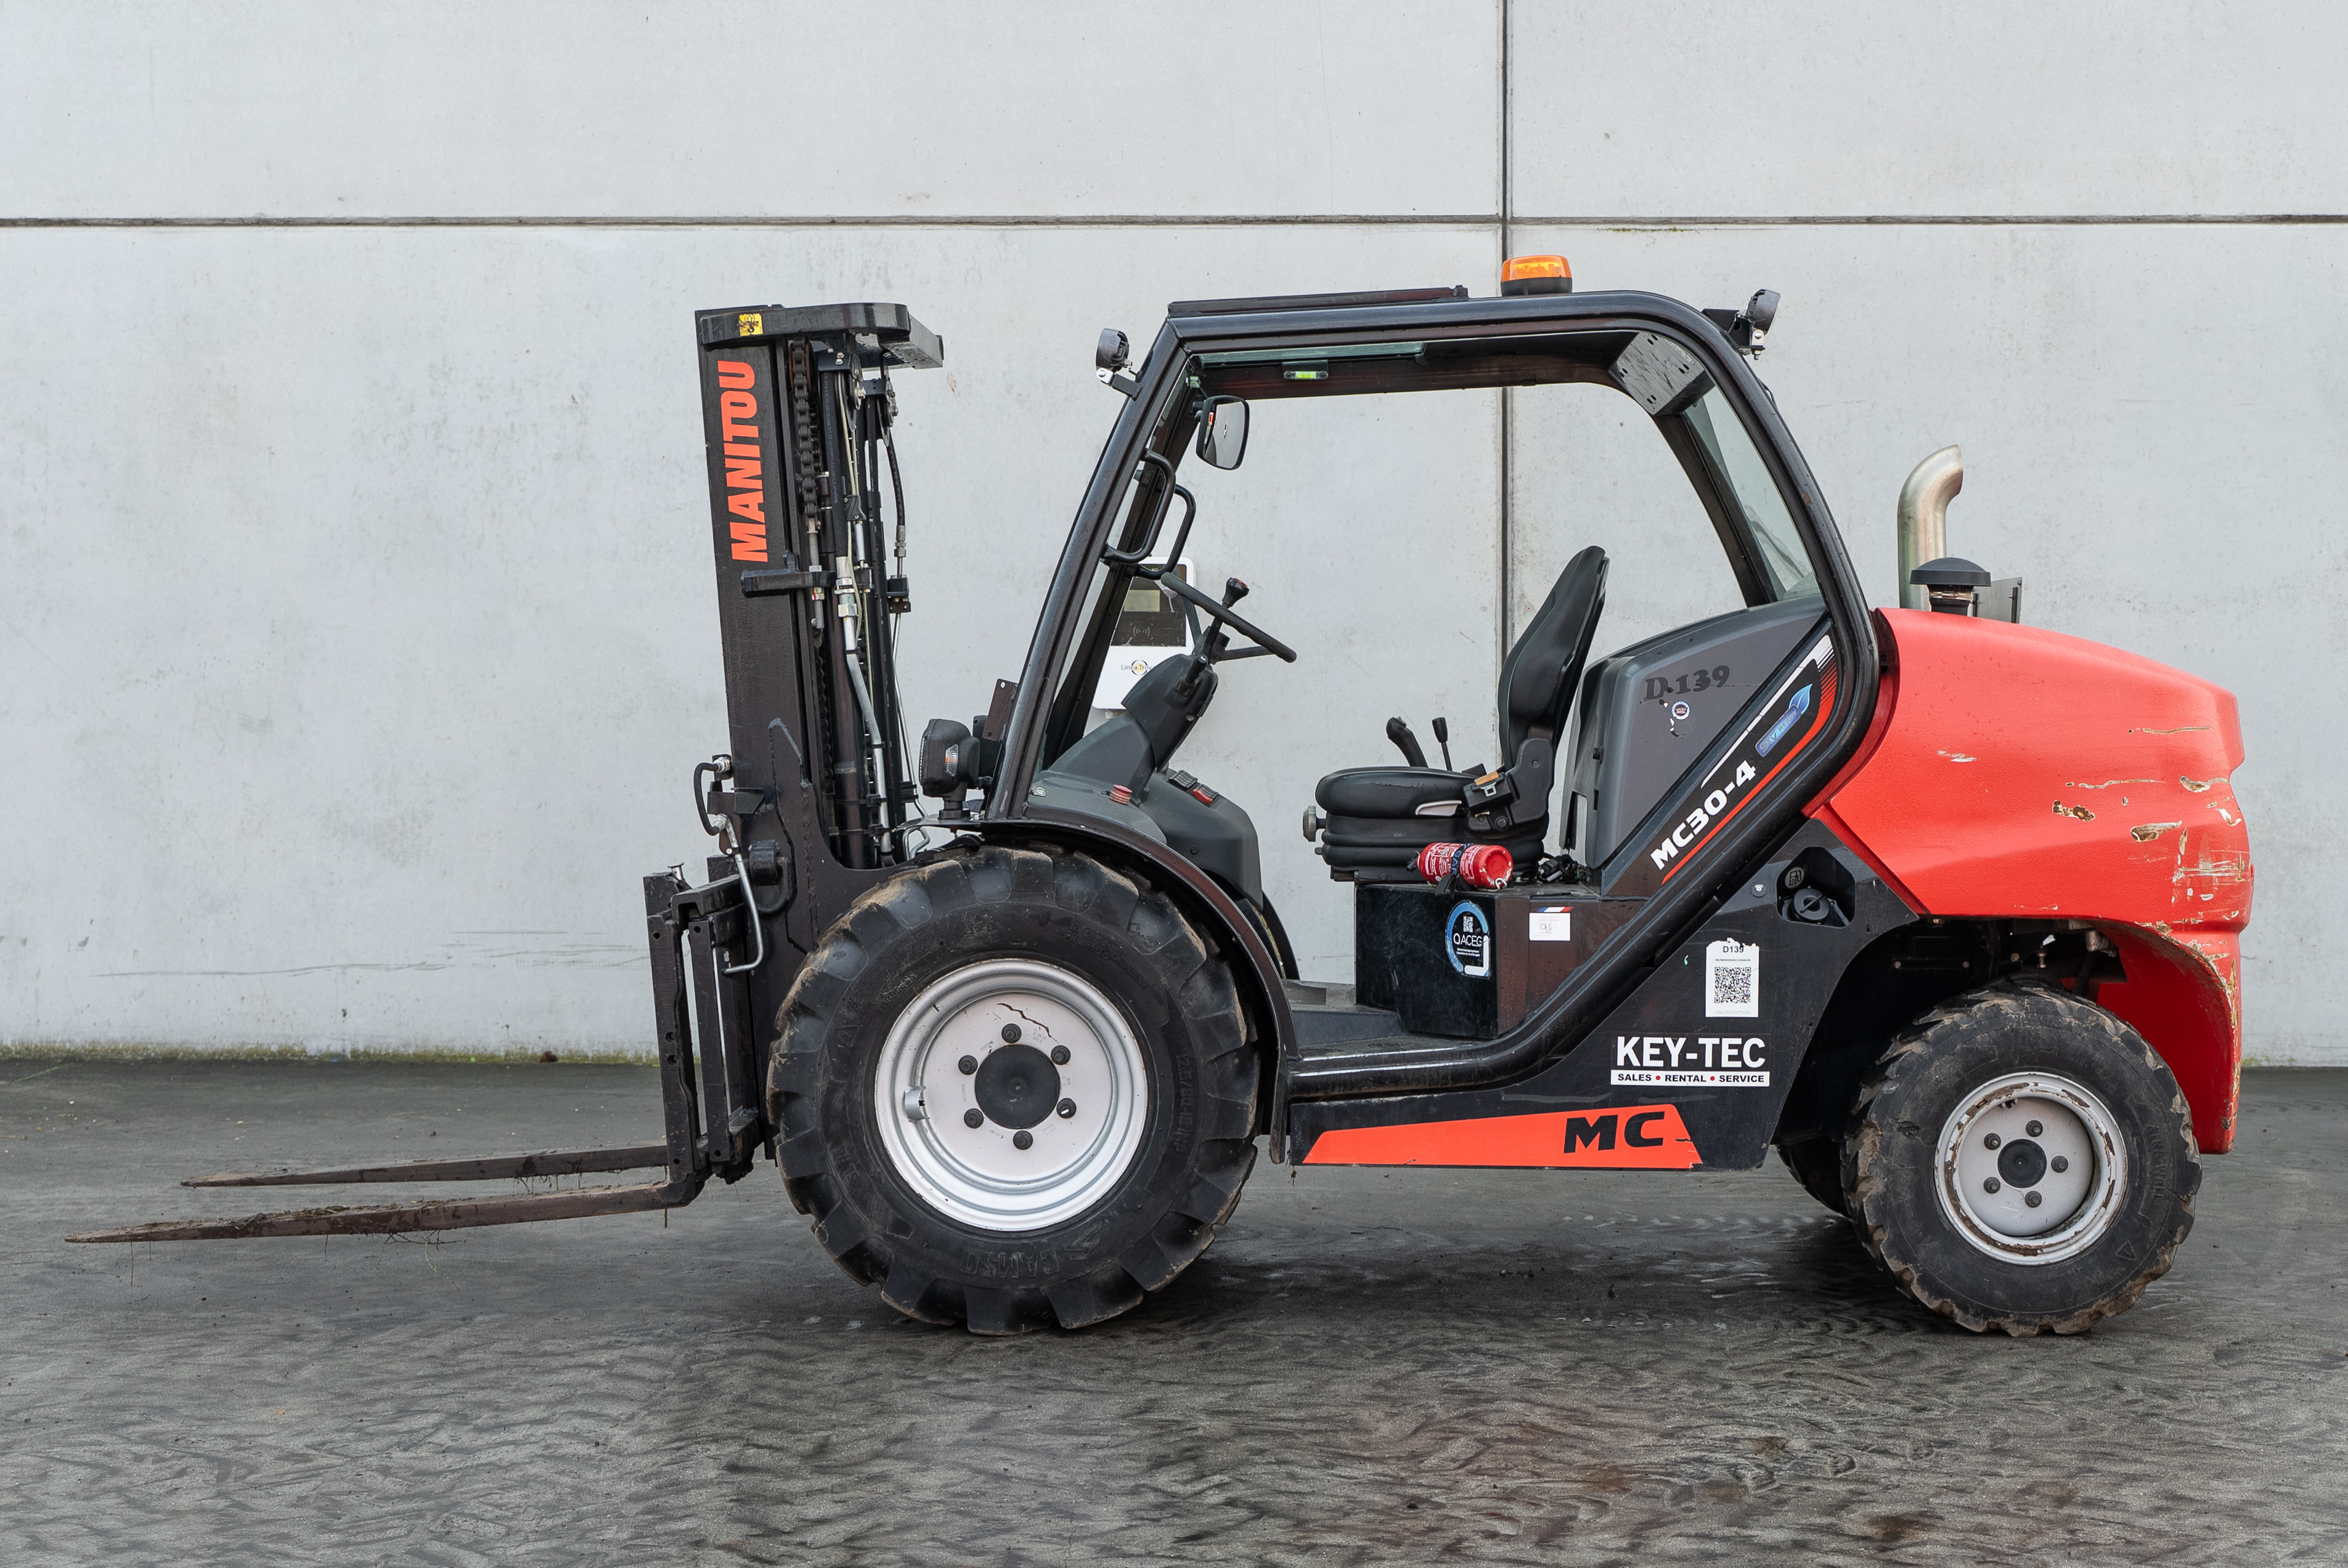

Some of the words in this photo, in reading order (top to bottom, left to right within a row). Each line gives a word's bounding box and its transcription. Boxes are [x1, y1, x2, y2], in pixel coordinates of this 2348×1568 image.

[717, 360, 768, 563] MANITOU
[1778, 710, 1797, 732] READY
[1650, 760, 1756, 871] MC30-4
[1453, 933, 1482, 947] QACEG
[1617, 1036, 1766, 1068] KEY-TEC
[1665, 1074, 1706, 1083] RENTAL
[1563, 1111, 1665, 1153] MC
[960, 1248, 1060, 1279] CAMSO
